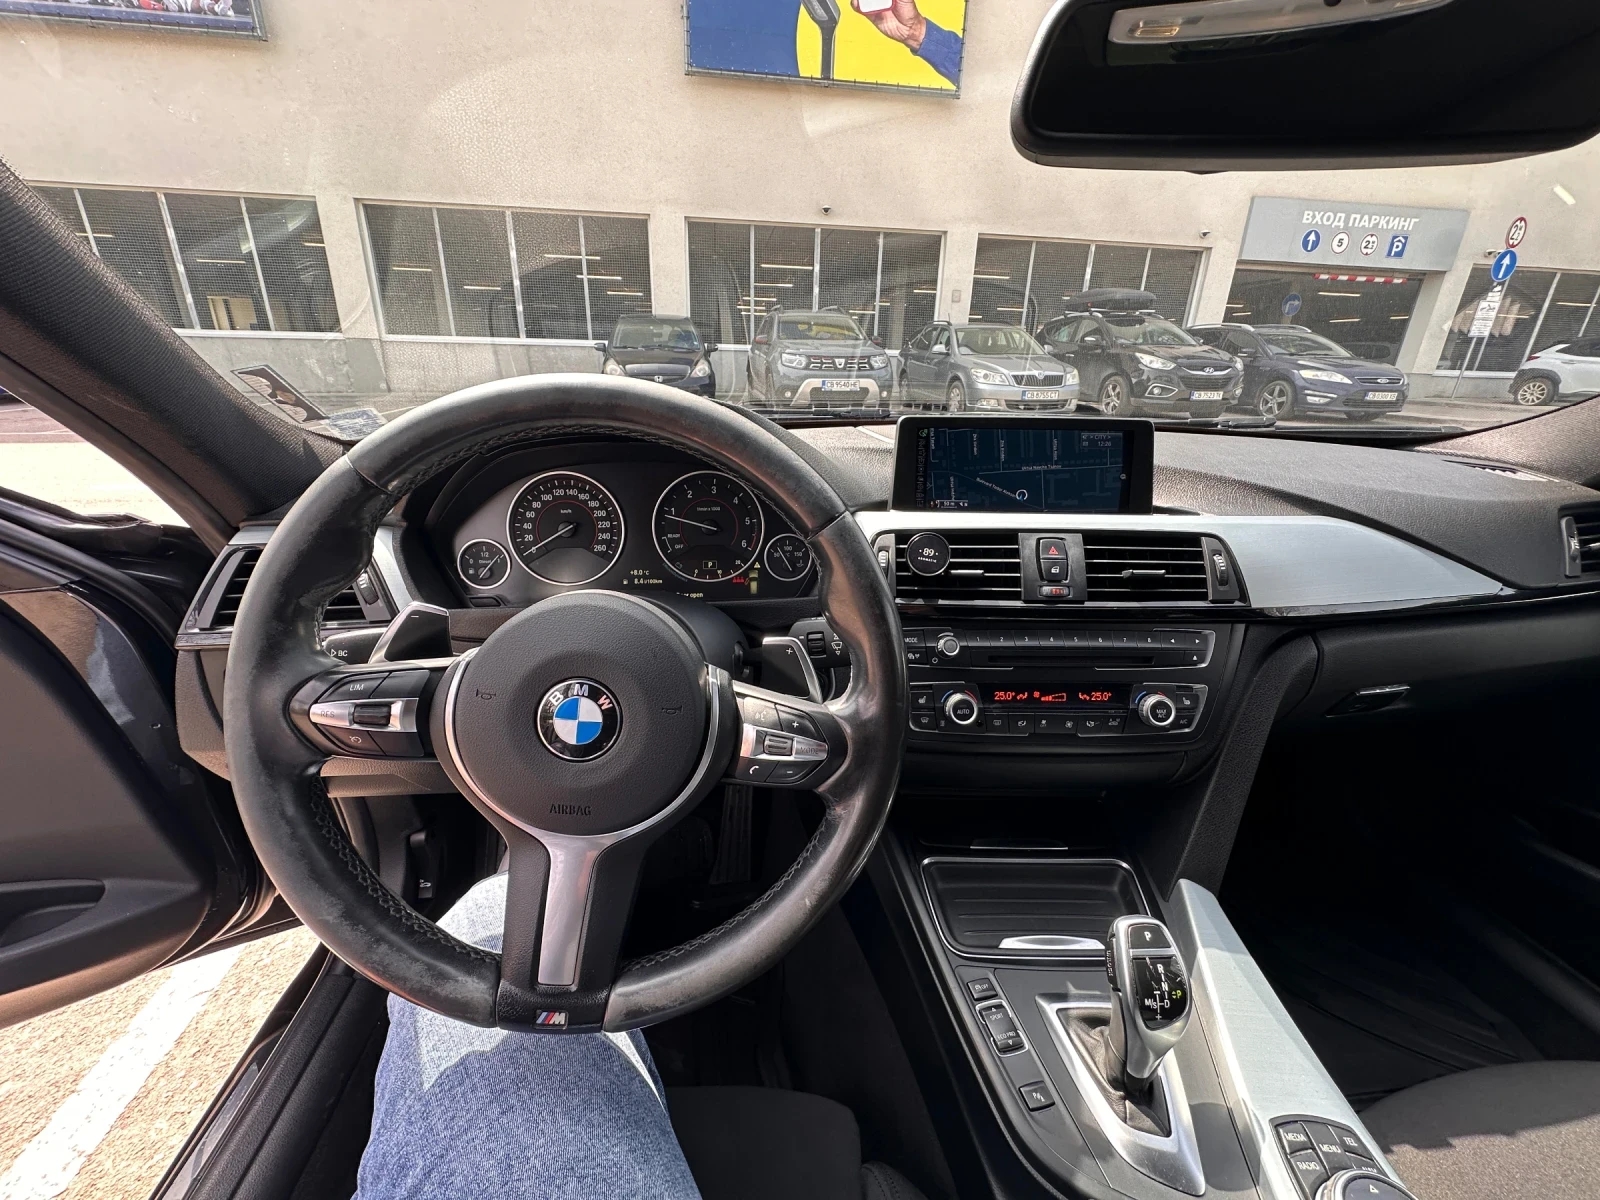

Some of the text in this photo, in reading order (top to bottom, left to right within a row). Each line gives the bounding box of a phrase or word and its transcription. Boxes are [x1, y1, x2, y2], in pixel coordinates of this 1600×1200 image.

[1302, 210, 1420, 230] ВХОД ПАРКИНГ
[1337, 238, 1344, 247] 5
[1391, 242, 1402, 256] P
[549, 684, 612, 710] BMW
[549, 803, 592, 816] AIRBAG
[1144, 932, 1152, 941] P
[1157, 964, 1165, 973] R
[1161, 982, 1168, 991] N
[1164, 1000, 1170, 1008] D
[1284, 1132, 1307, 1142] MEDIA
[1343, 1137, 1358, 1146] TEL
[1319, 1144, 1341, 1153] MENU
[1297, 1162, 1320, 1170] RADIO
